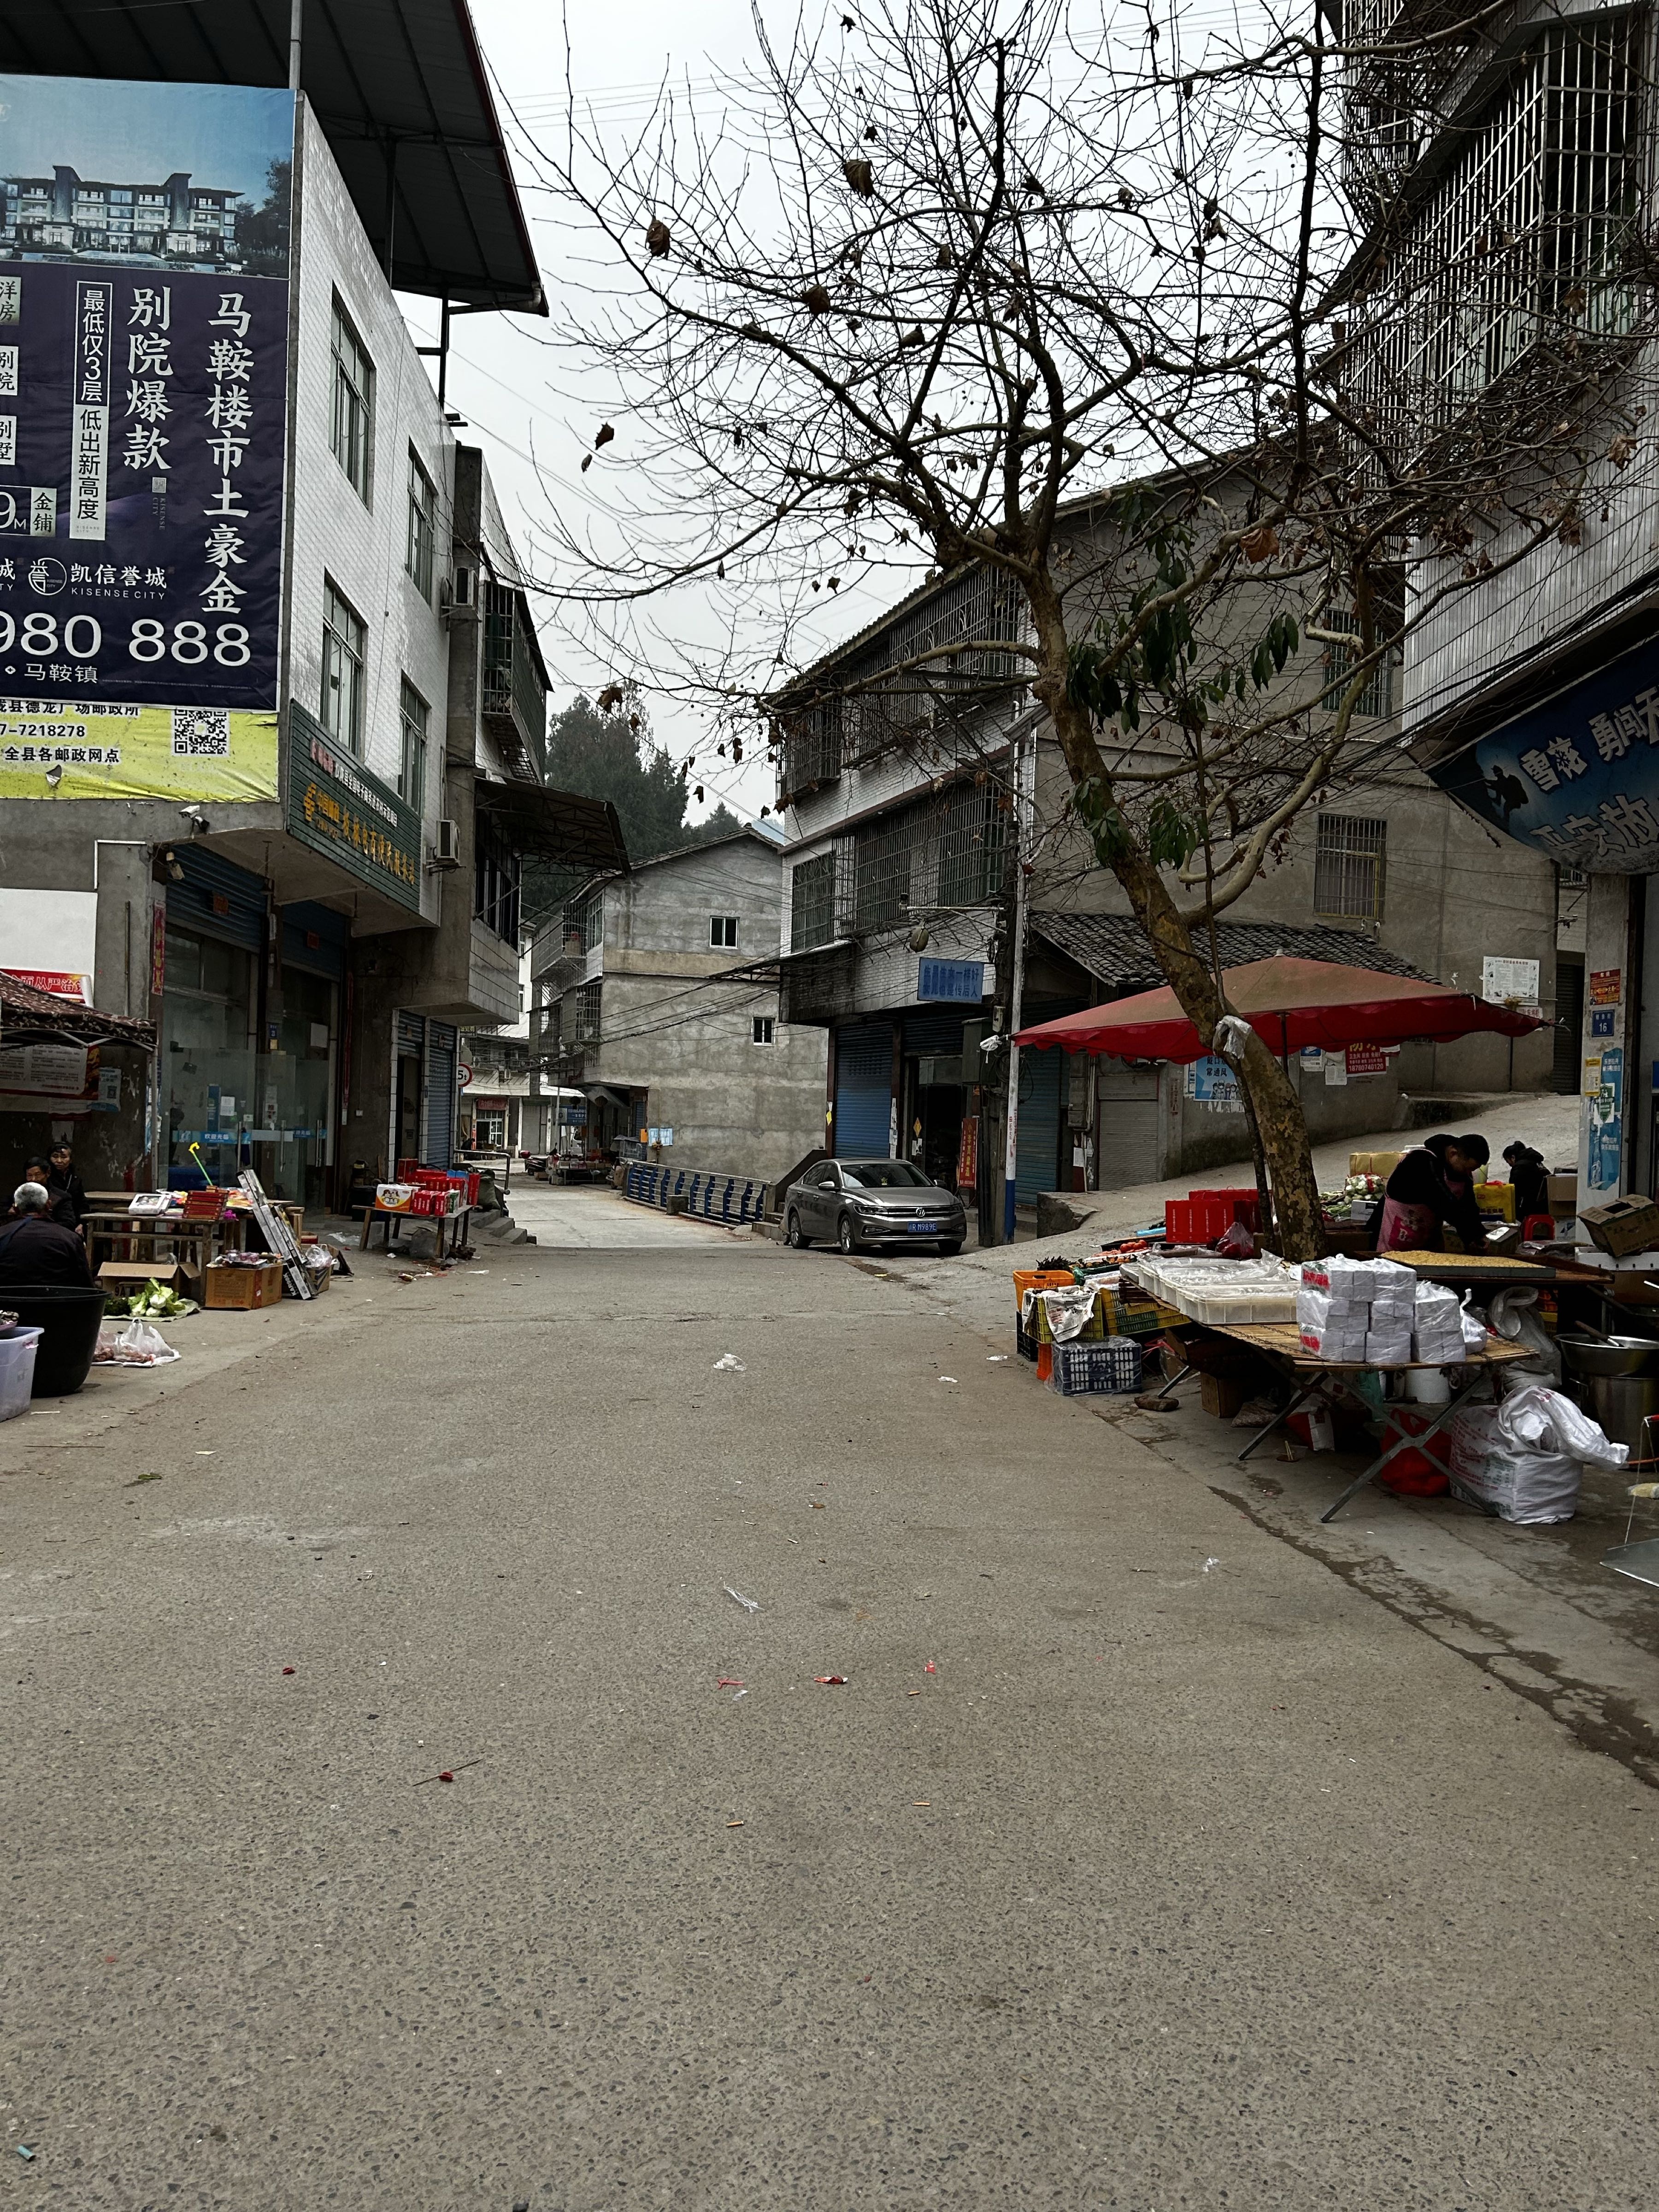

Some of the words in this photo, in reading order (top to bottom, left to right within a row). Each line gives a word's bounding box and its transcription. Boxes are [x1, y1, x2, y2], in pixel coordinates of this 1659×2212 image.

[81, 290, 105, 403] 最低仅3层
[122, 286, 174, 470] 别院爆款
[76, 408, 102, 520] 低出新高度
[199, 293, 254, 615] 马鞍楼市土豪金
[33, 492, 54, 533] 金铺
[70, 562, 167, 589] 凯信誉城
[71, 587, 129, 598] KISENSE
[135, 591, 165, 600] CITY
[129, 618, 251, 666] 888
[24, 663, 98, 684] 马鞍镇
[5, 746, 120, 763] 全县各邮政网点
[1520, 736, 1588, 791] 雪花
[1599, 1022, 1607, 1032] 16
